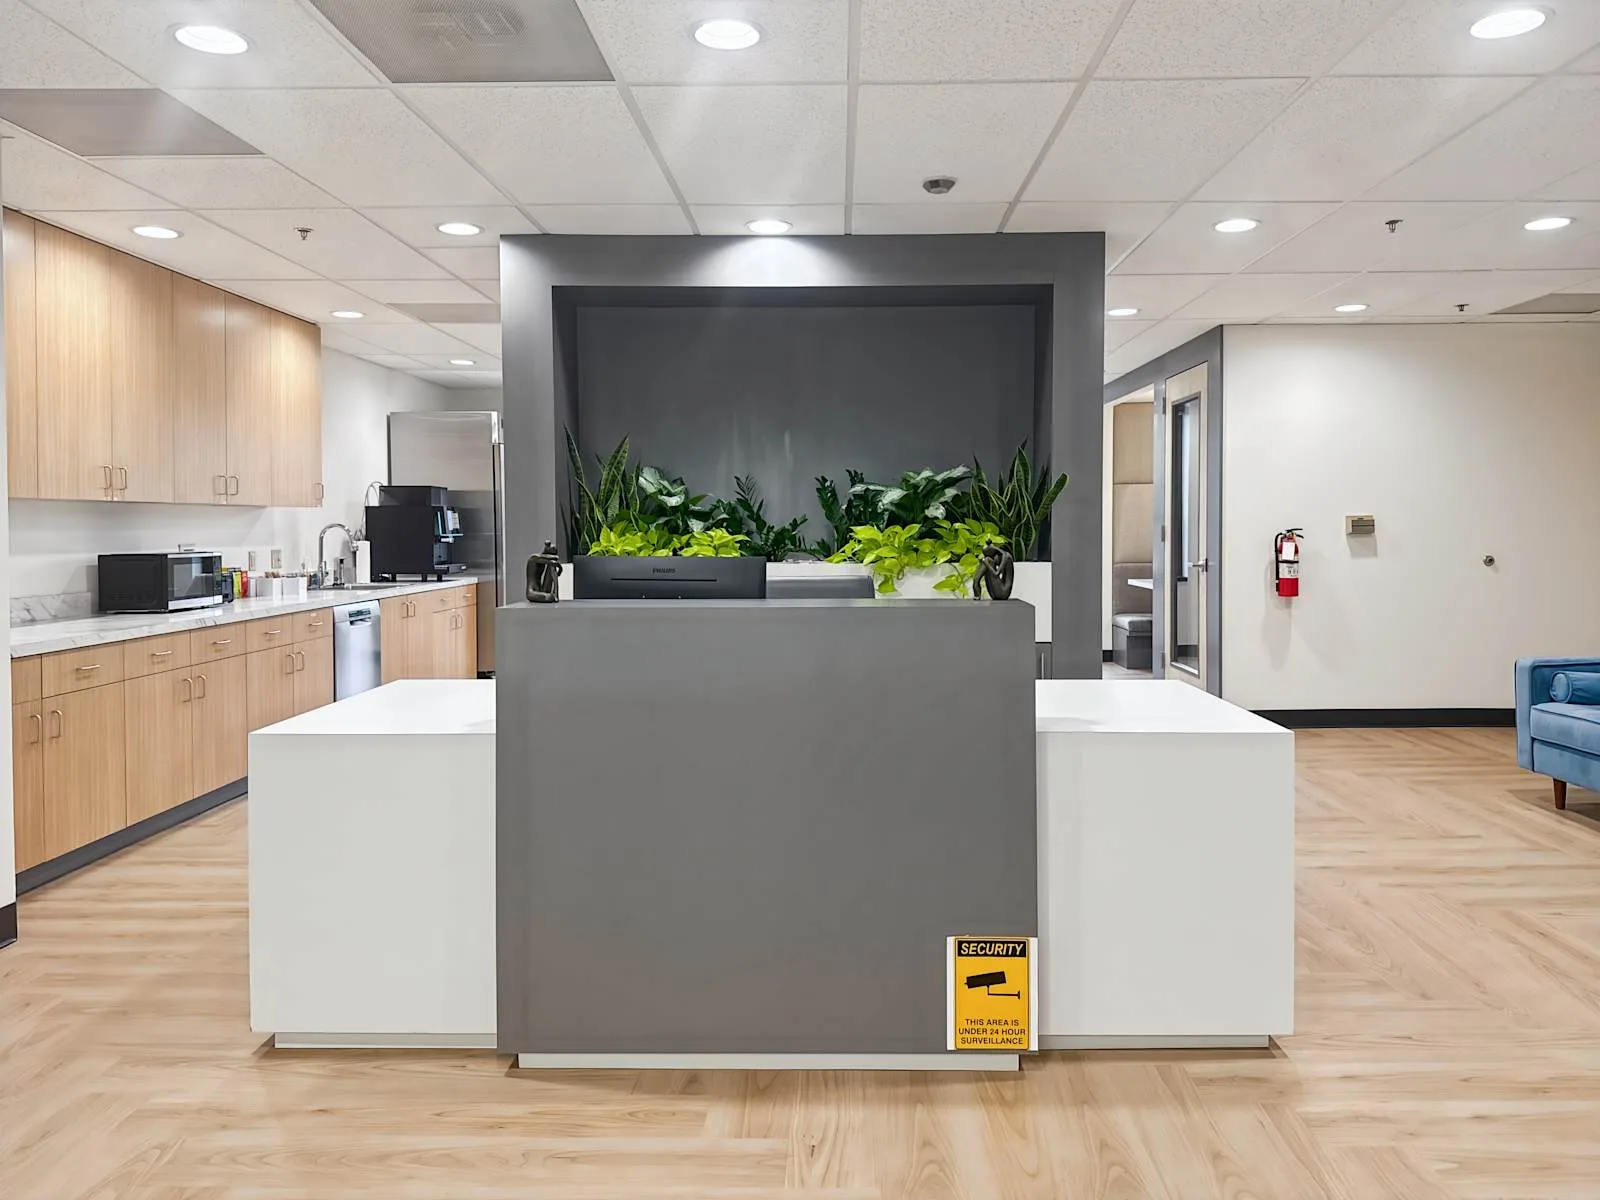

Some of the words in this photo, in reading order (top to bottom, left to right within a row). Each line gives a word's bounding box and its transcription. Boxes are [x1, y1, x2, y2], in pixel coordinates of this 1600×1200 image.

[960, 943, 1024, 955] SECURITY
[986, 1018, 1009, 1026] AREA
[960, 1037, 1023, 1045] SURVEILLANCE
